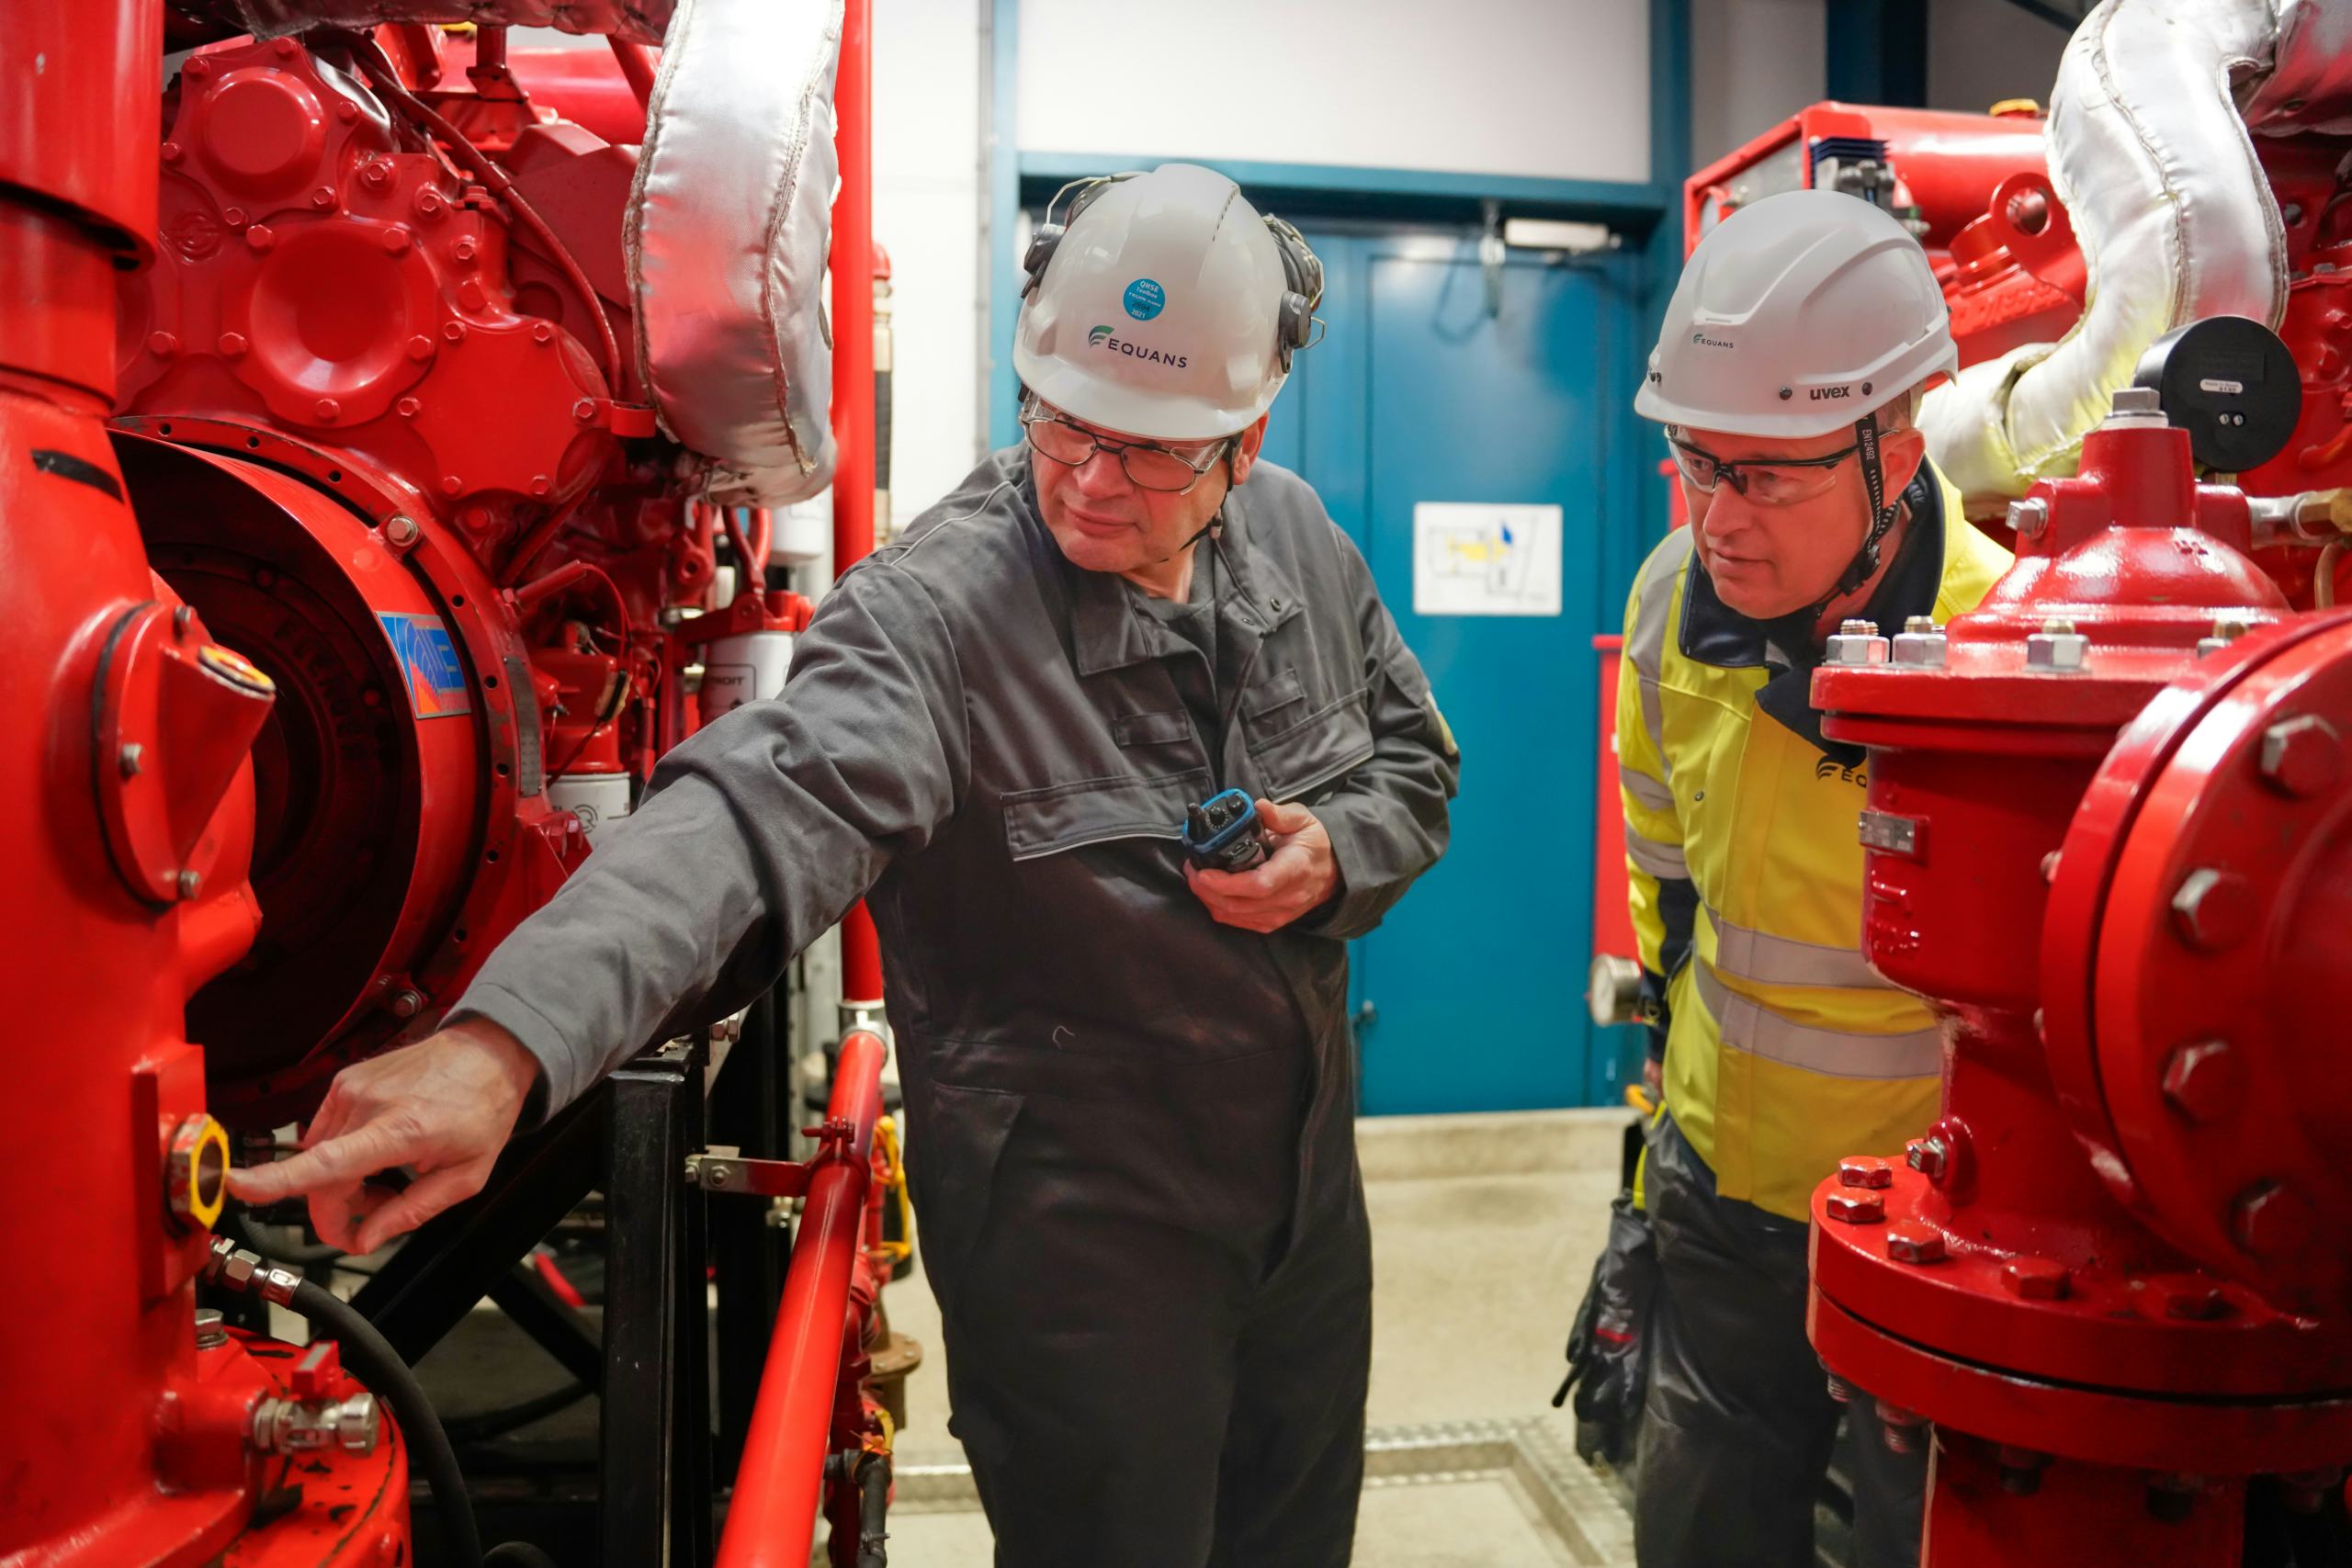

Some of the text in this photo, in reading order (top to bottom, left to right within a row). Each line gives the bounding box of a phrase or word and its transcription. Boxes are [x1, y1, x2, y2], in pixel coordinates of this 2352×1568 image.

[1140, 280, 1159, 292] QHSE
[1131, 310, 1146, 319] 2021
[1701, 339, 1734, 348] EQUANS
[1108, 338, 1188, 368] EQUANS
[1810, 385, 1850, 400] uvex
